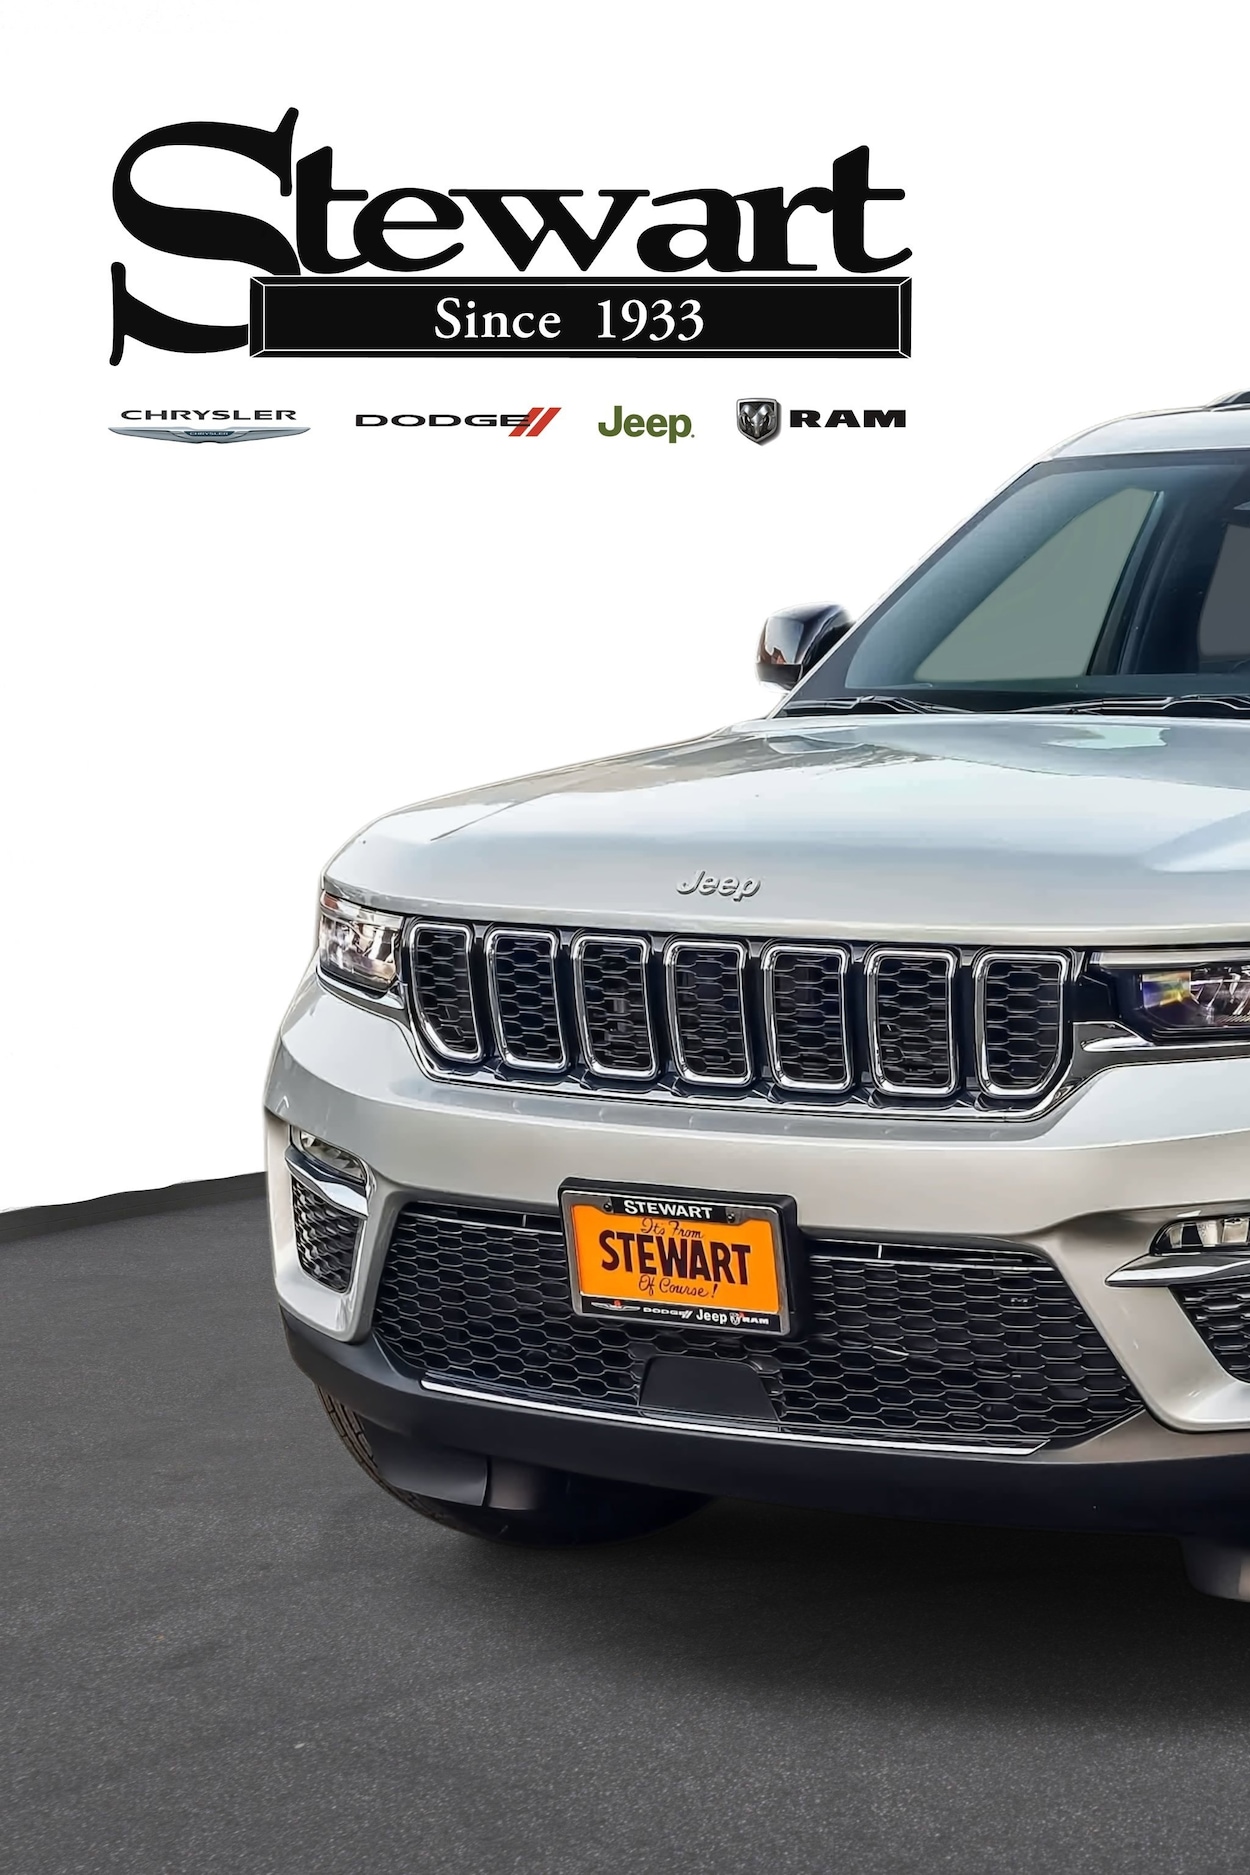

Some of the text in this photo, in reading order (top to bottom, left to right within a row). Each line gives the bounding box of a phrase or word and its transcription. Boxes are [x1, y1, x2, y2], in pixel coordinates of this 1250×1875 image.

[677, 870, 761, 902] Jeep
[624, 1201, 712, 1219] STEWART
[668, 1221, 704, 1239] From
[600, 1231, 751, 1285] STEWART
[638, 1275, 656, 1296] Of
[643, 1308, 686, 1318] DODGE
[696, 1309, 728, 1324] Jeep
[743, 1316, 770, 1325] RAM
